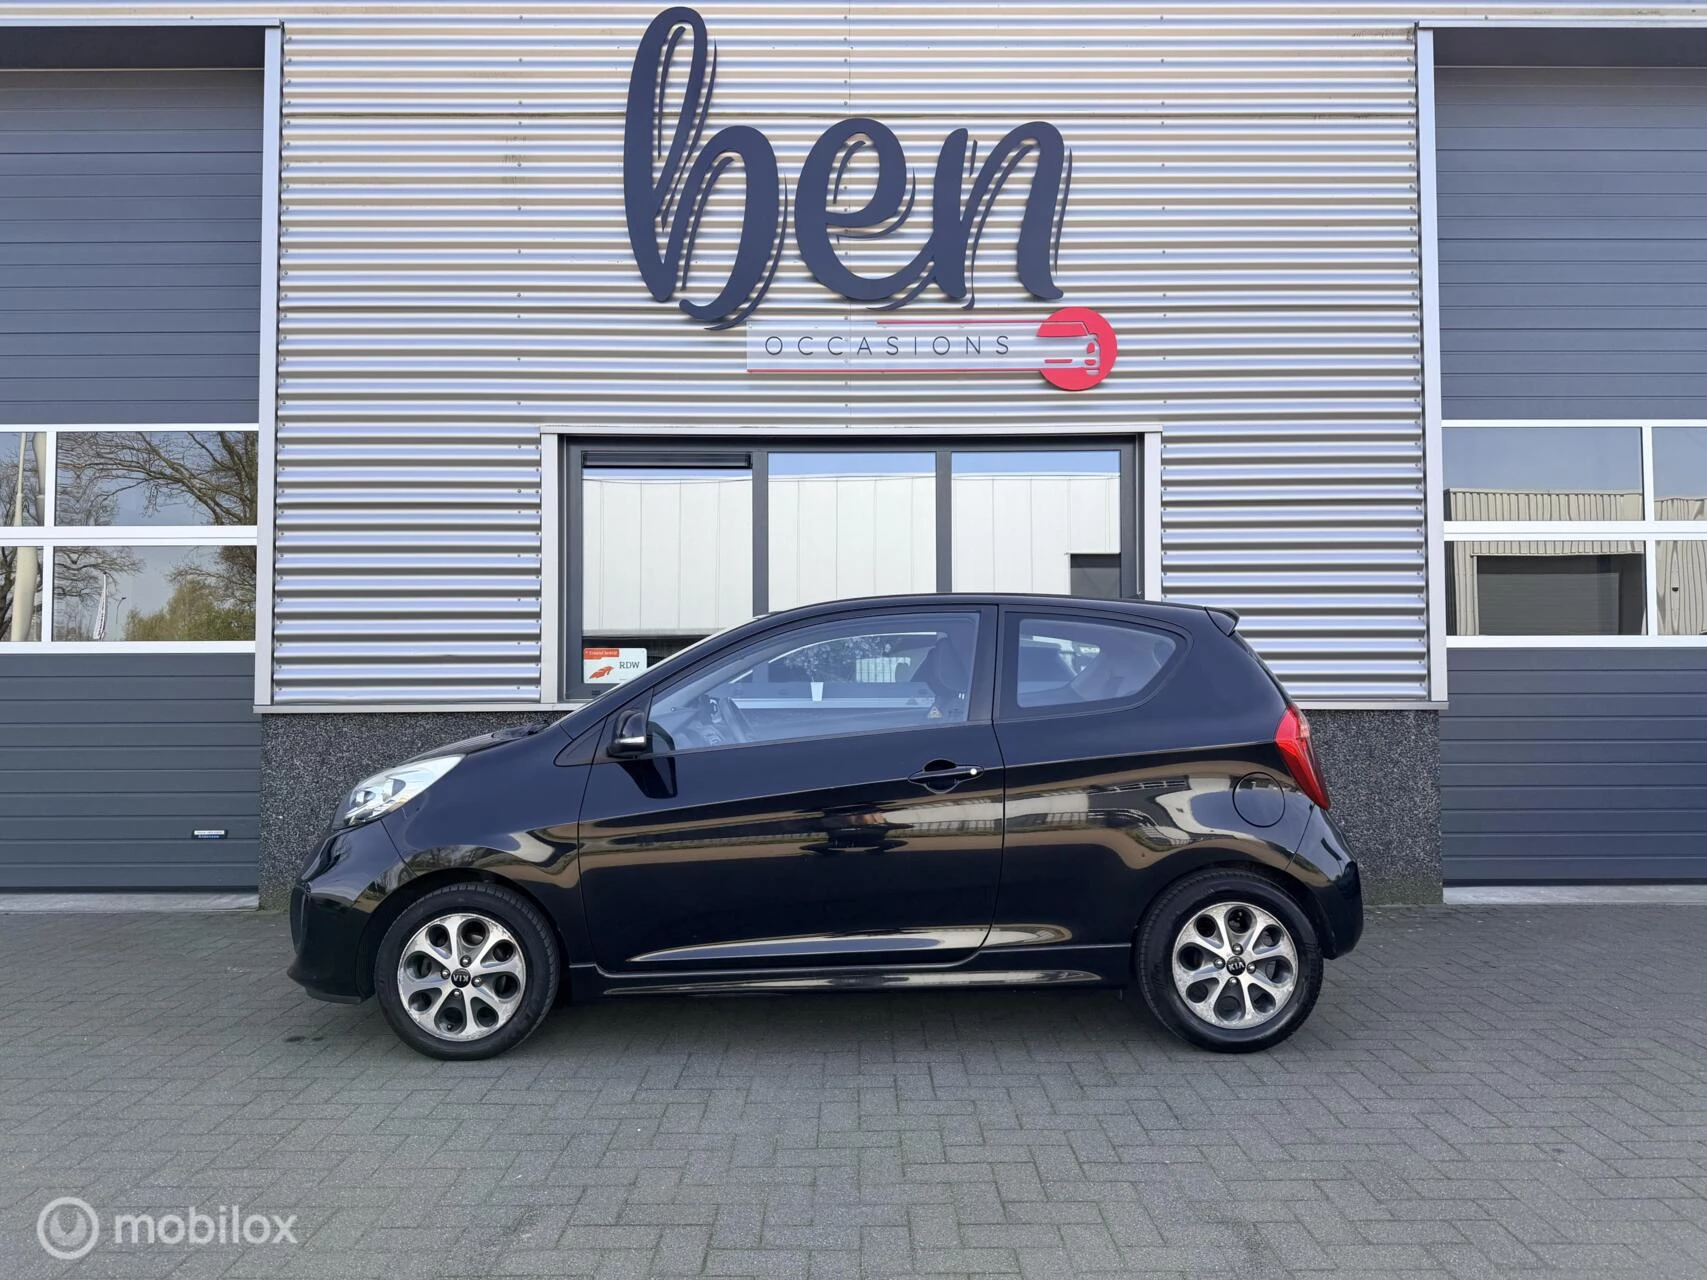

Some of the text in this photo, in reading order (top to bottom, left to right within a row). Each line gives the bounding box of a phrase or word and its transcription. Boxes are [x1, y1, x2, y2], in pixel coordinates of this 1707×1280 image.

[624, 6, 1073, 330] ben
[765, 336, 1009, 356] OCCASIONS
[619, 661, 640, 669] RDW
[1228, 961, 1245, 971] KIA
